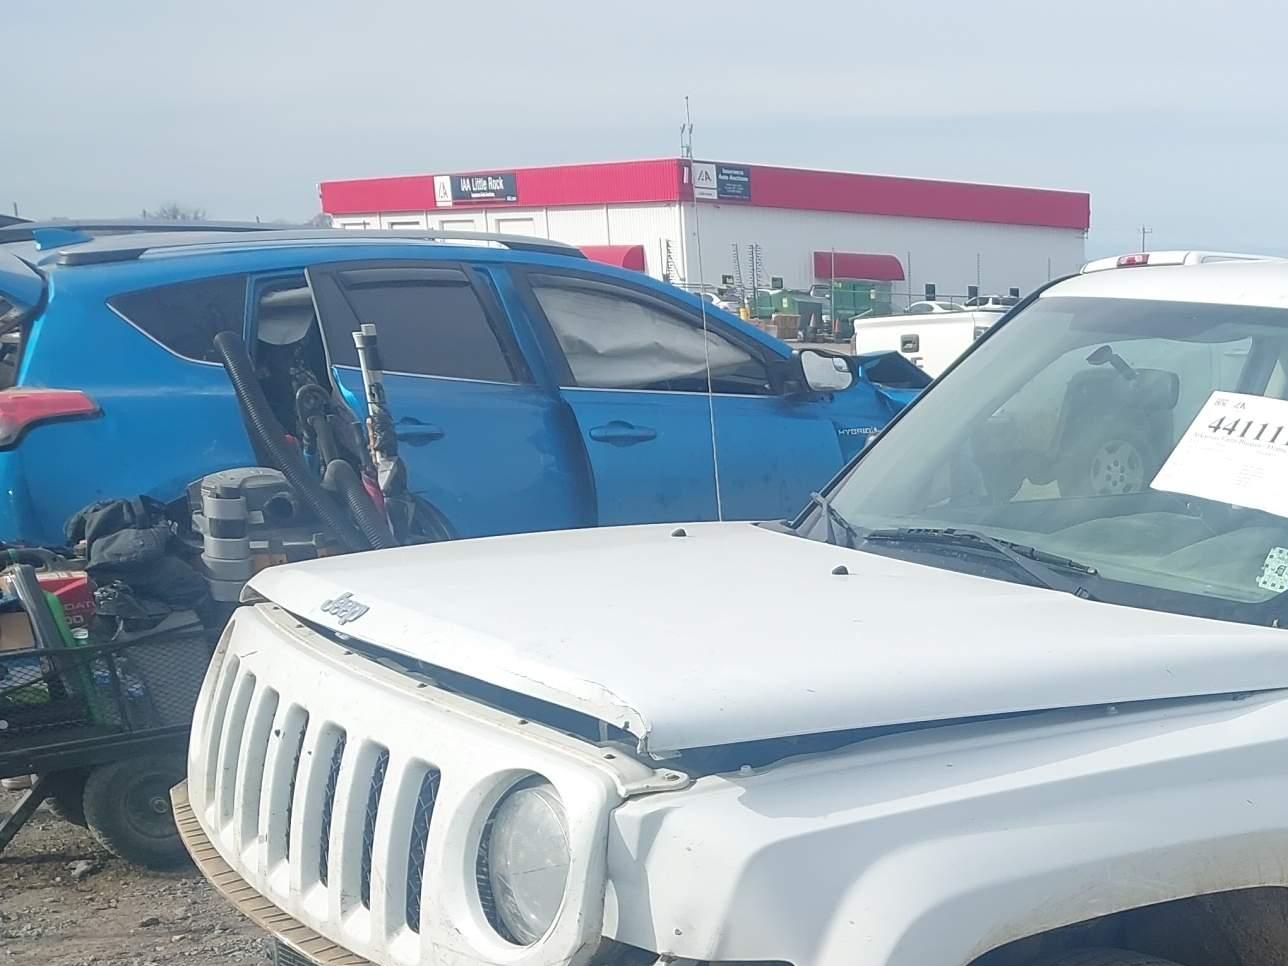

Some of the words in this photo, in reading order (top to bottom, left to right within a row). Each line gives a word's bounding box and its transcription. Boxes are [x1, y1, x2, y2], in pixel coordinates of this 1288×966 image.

[460, 178, 471, 192] IAA
[471, 177, 488, 191] Little
[488, 176, 504, 190] Rock
[320, 591, 370, 626] Jeep
